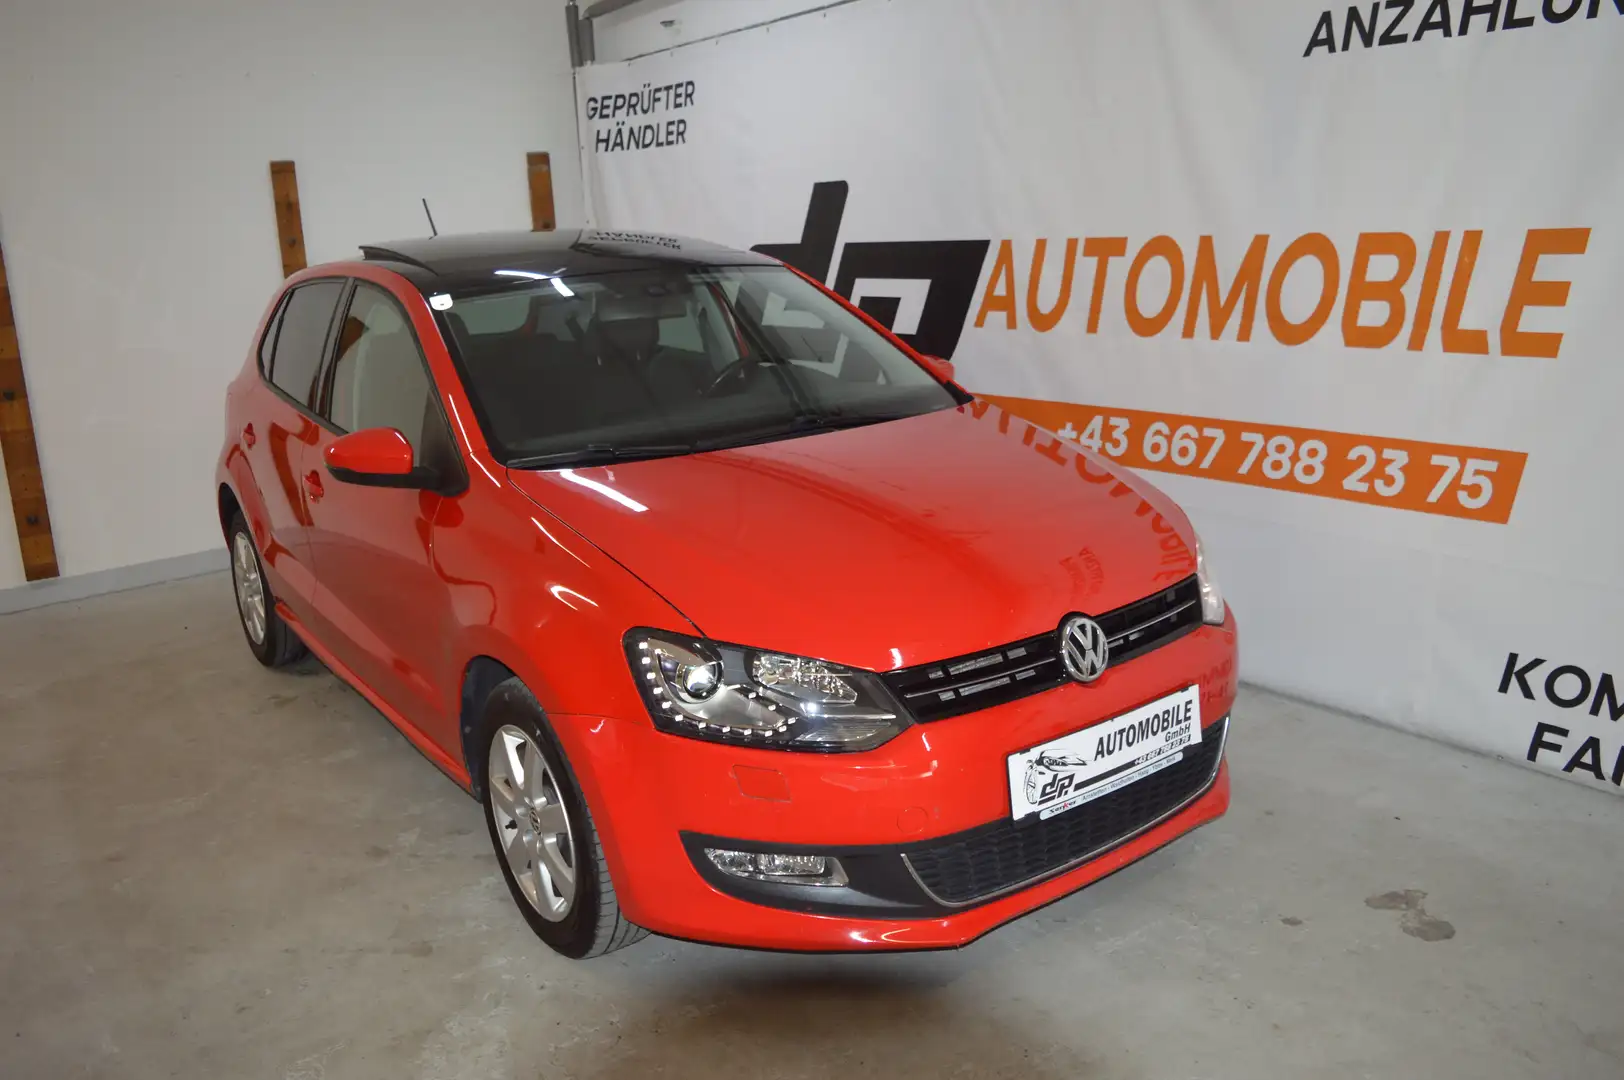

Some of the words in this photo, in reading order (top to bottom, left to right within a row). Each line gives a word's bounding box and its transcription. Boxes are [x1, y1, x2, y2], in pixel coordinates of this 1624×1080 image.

[1302, 0, 1624, 58] ANZAHL
[586, 80, 695, 120] GEPRÜFTER
[595, 119, 687, 153] HÄNDLER
[973, 227, 1592, 359] AUTOMOBILE
[1057, 415, 1130, 457] +43
[1143, 421, 1226, 469] 667
[1236, 431, 1328, 485] 788
[1342, 445, 1409, 497] 23
[1425, 454, 1499, 509] 75
[1093, 699, 1193, 762] AUTOMOBILE
[1165, 722, 1191, 743] GmbH
[1526, 721, 1624, 787] FA
